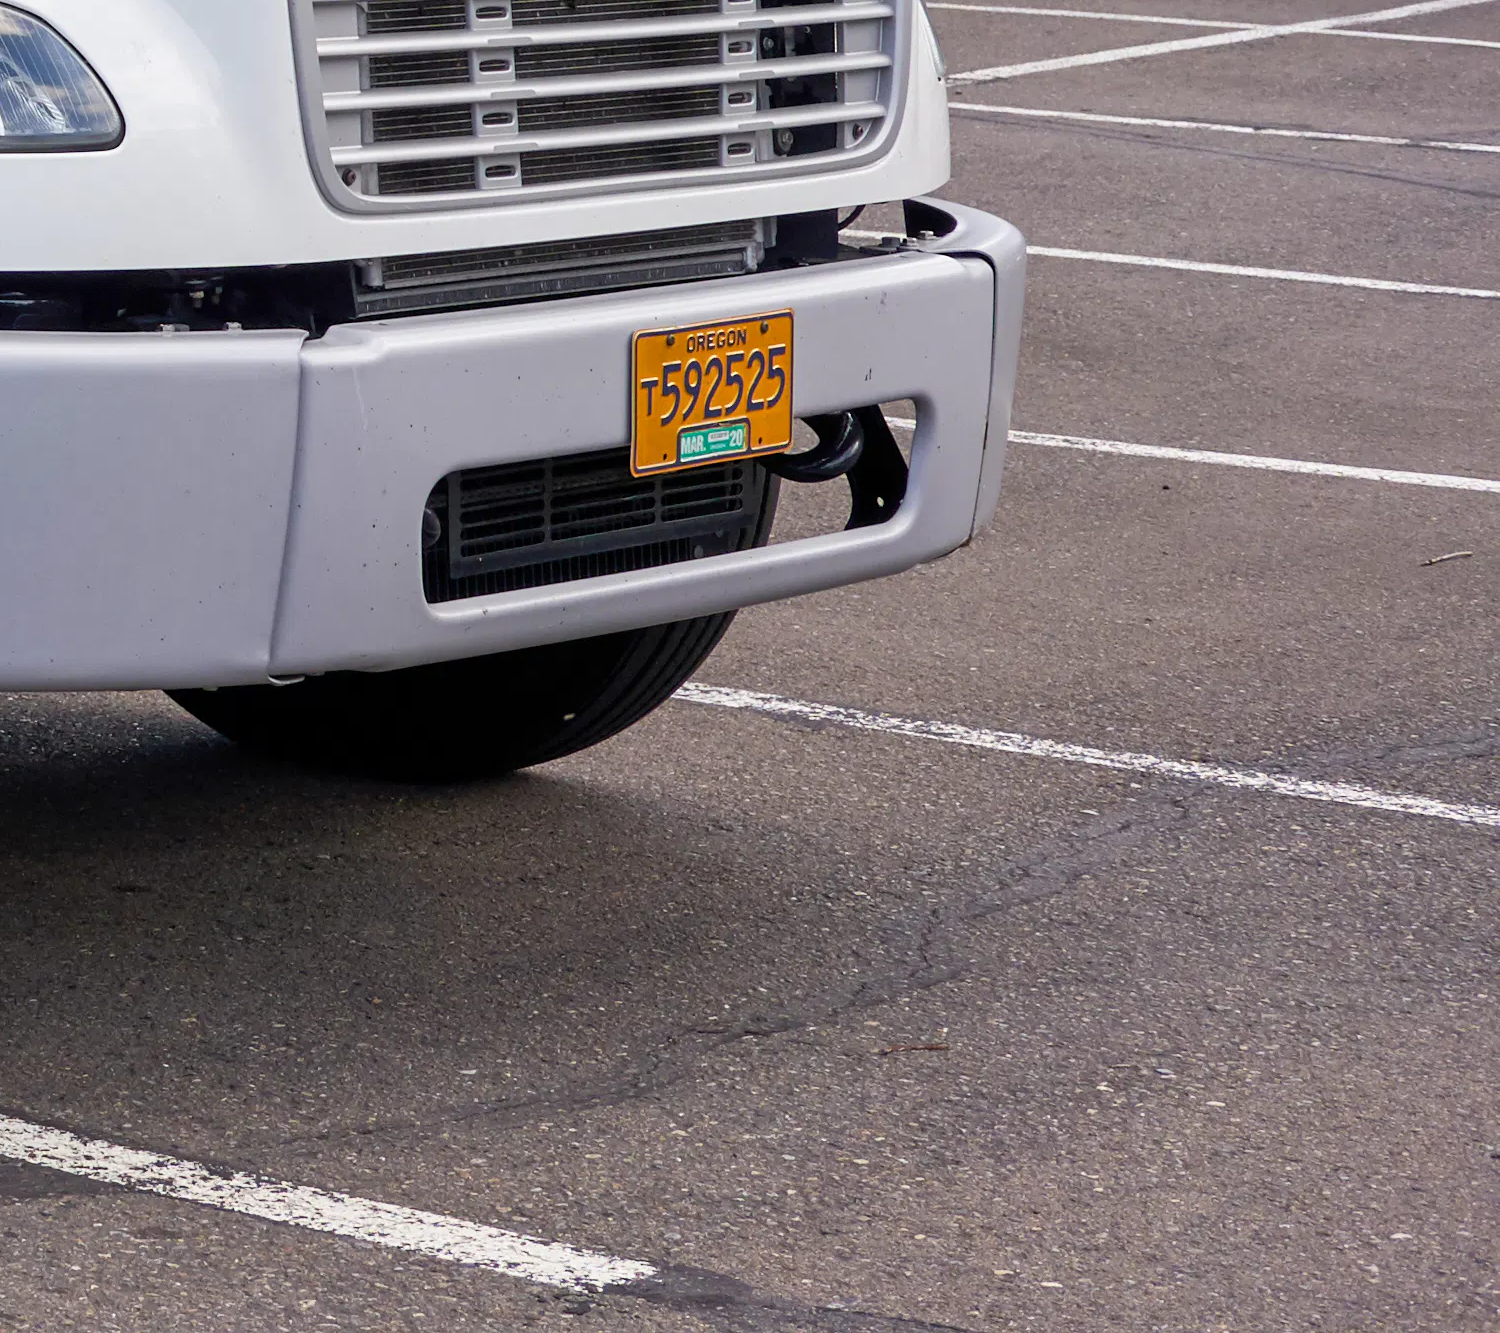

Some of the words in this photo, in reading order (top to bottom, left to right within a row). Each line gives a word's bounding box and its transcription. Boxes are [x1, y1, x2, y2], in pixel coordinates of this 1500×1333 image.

[686, 328, 747, 353] OREGON
[640, 343, 786, 427] T592525
[729, 428, 743, 447] 20
